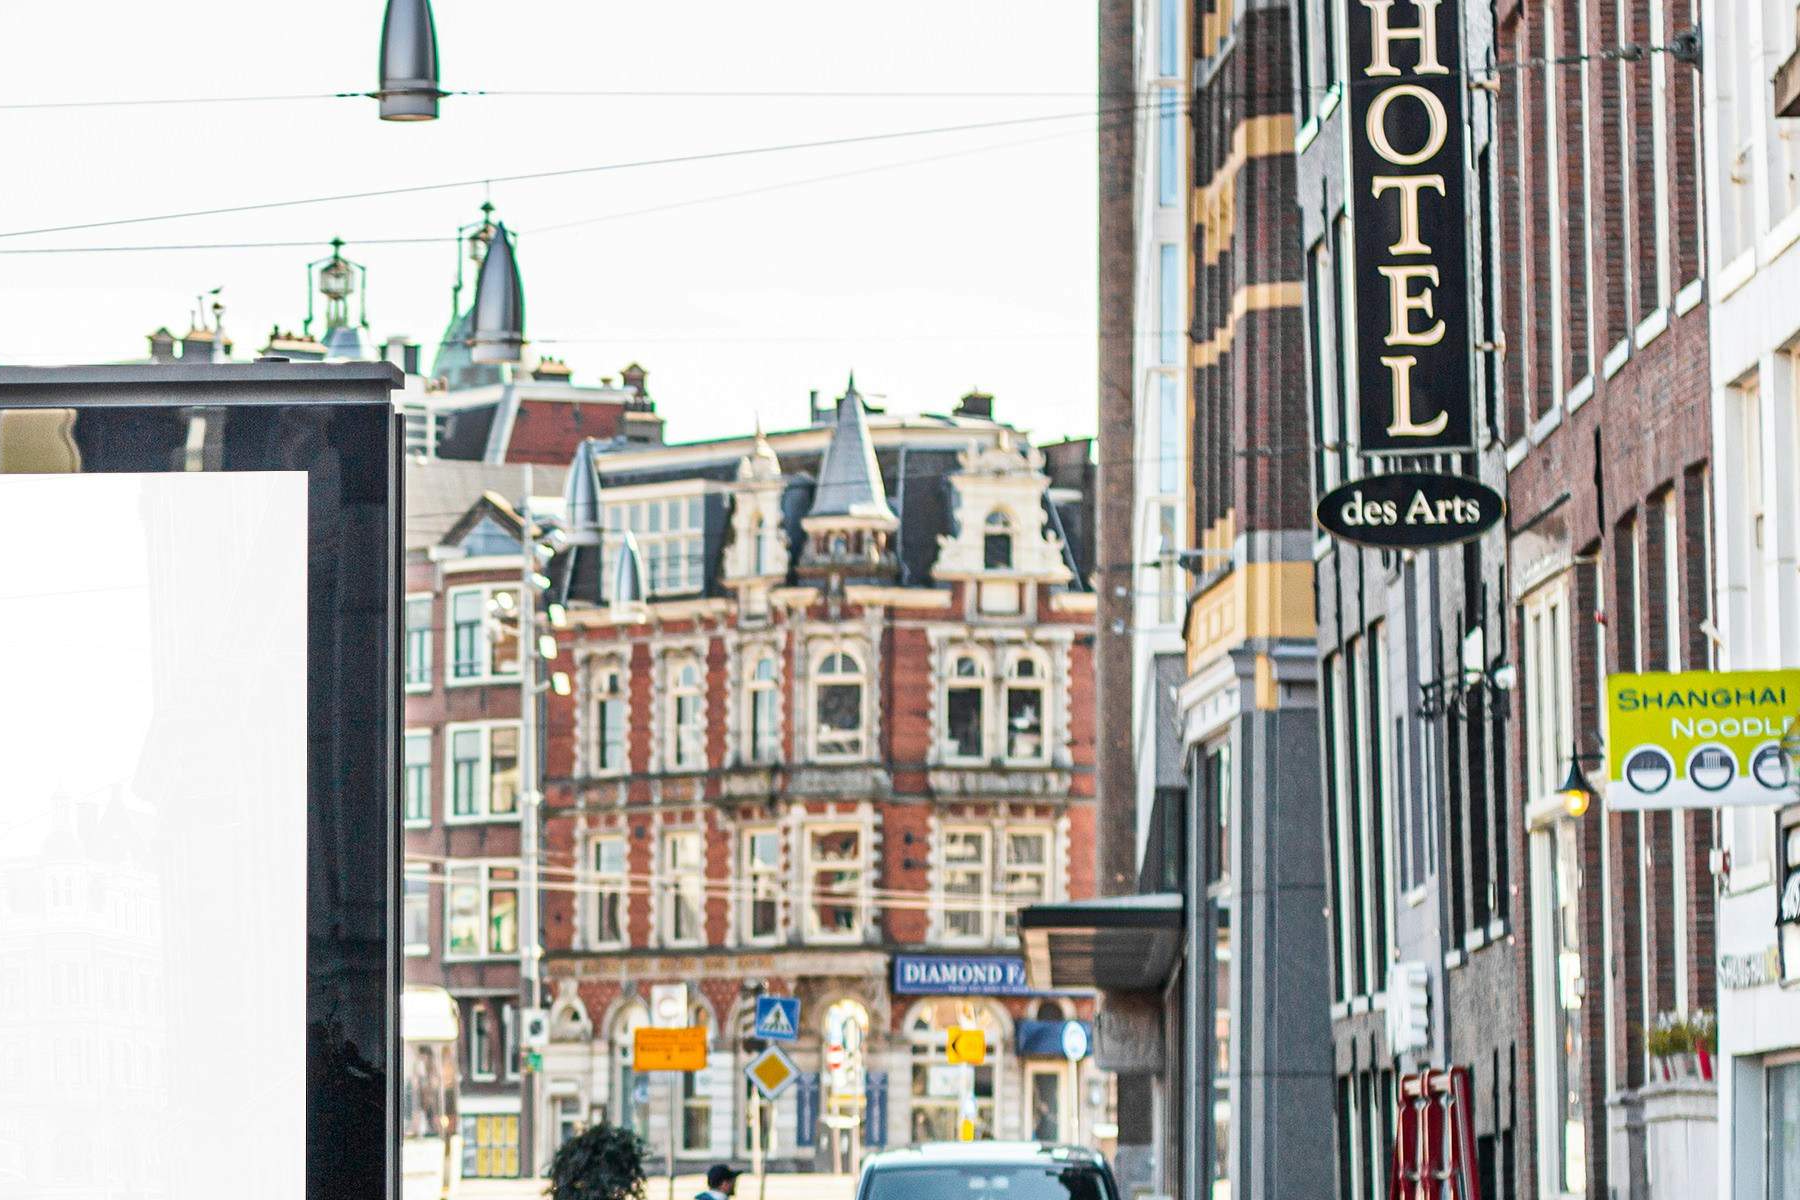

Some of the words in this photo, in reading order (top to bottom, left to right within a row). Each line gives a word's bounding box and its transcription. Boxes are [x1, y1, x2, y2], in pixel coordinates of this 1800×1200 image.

[1358, 0, 1450, 437] HOTEL
[1341, 489, 1398, 526] des
[1405, 488, 1481, 526] Arts
[1618, 686, 1786, 711] SHANGHAI
[903, 962, 1003, 984] DIAMOND
